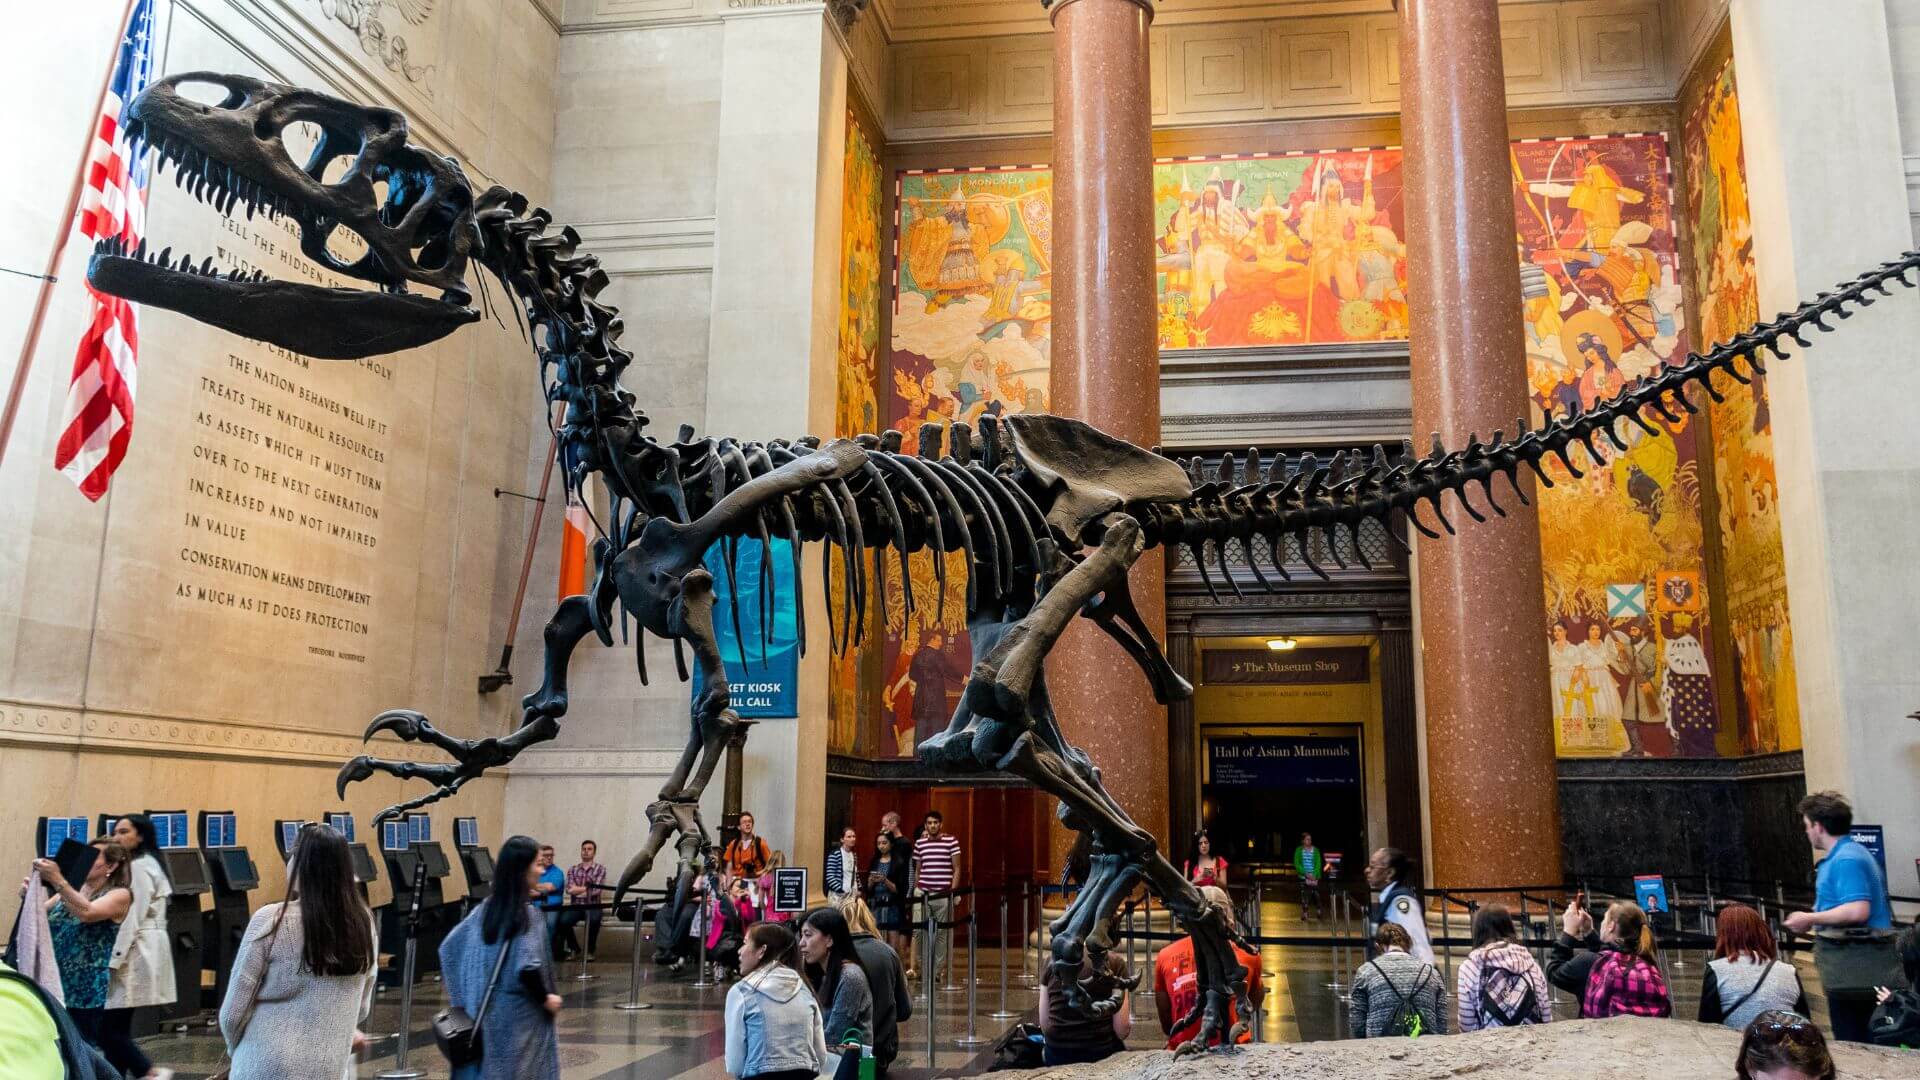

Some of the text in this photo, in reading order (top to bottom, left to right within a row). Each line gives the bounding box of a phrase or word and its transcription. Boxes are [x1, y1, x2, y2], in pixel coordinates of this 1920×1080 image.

[969, 177, 1025, 187] MONGOLIA
[221, 214, 247, 240] TELL
[254, 233, 275, 256] THE
[280, 249, 323, 283] HIDDEN
[338, 225, 363, 247] OPEN
[201, 376, 385, 463] TREATS THE NATURAL RESOURCES
[228, 354, 387, 435] THE NATION BEHAVES WELL IF IT
[197, 411, 382, 491] AS ASSETS WHICH IT MUST TURN
[193, 445, 379, 519] OVER TO THE NEXT GENERATION
[185, 512, 246, 541] IN VALUE
[189, 478, 376, 548] INCREASED AND NOT IMPAIRED
[181, 548, 371, 606] CONSERVATION MEANS DEVELOPMENT
[176, 583, 369, 635] AS MUCH AS IT DOES PROTECTION
[728, 683, 781, 693] KET KIOSK
[1243, 660, 1340, 673] The Museum Shop
[729, 697, 772, 707] ILL CALL
[1215, 744, 1350, 758] Hall of Asian Mammals
